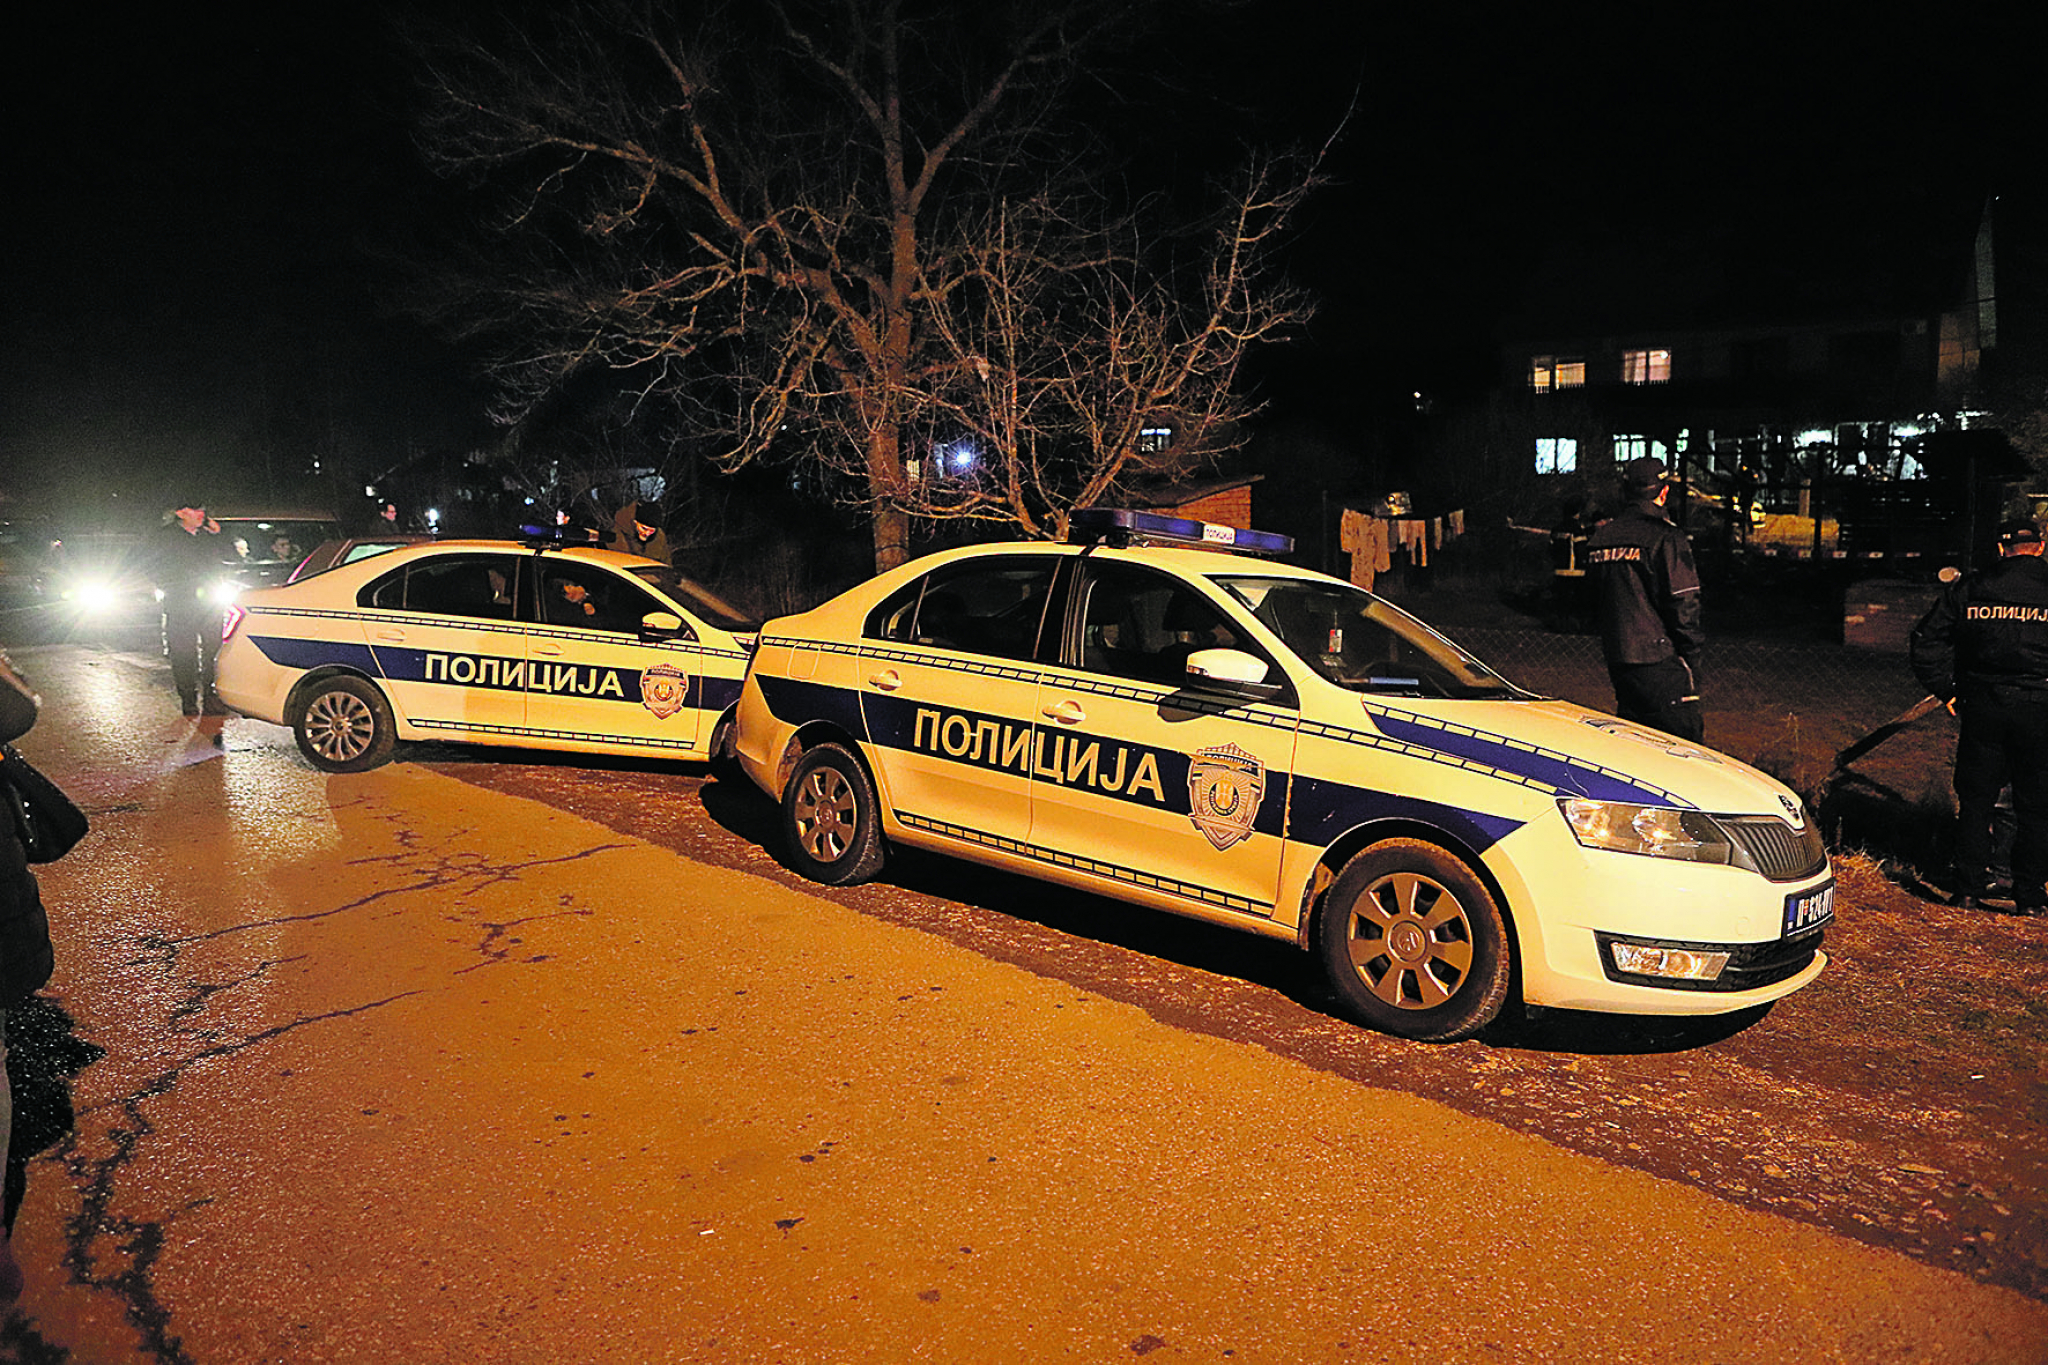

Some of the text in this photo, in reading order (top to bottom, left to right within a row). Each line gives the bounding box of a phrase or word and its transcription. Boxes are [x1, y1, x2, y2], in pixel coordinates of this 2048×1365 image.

[1967, 605, 2048, 623] ПОЛИЦИЈ
[424, 653, 625, 698] ПОЛИЦИЈА
[913, 707, 1166, 803] ПОЛИЦИЈА
